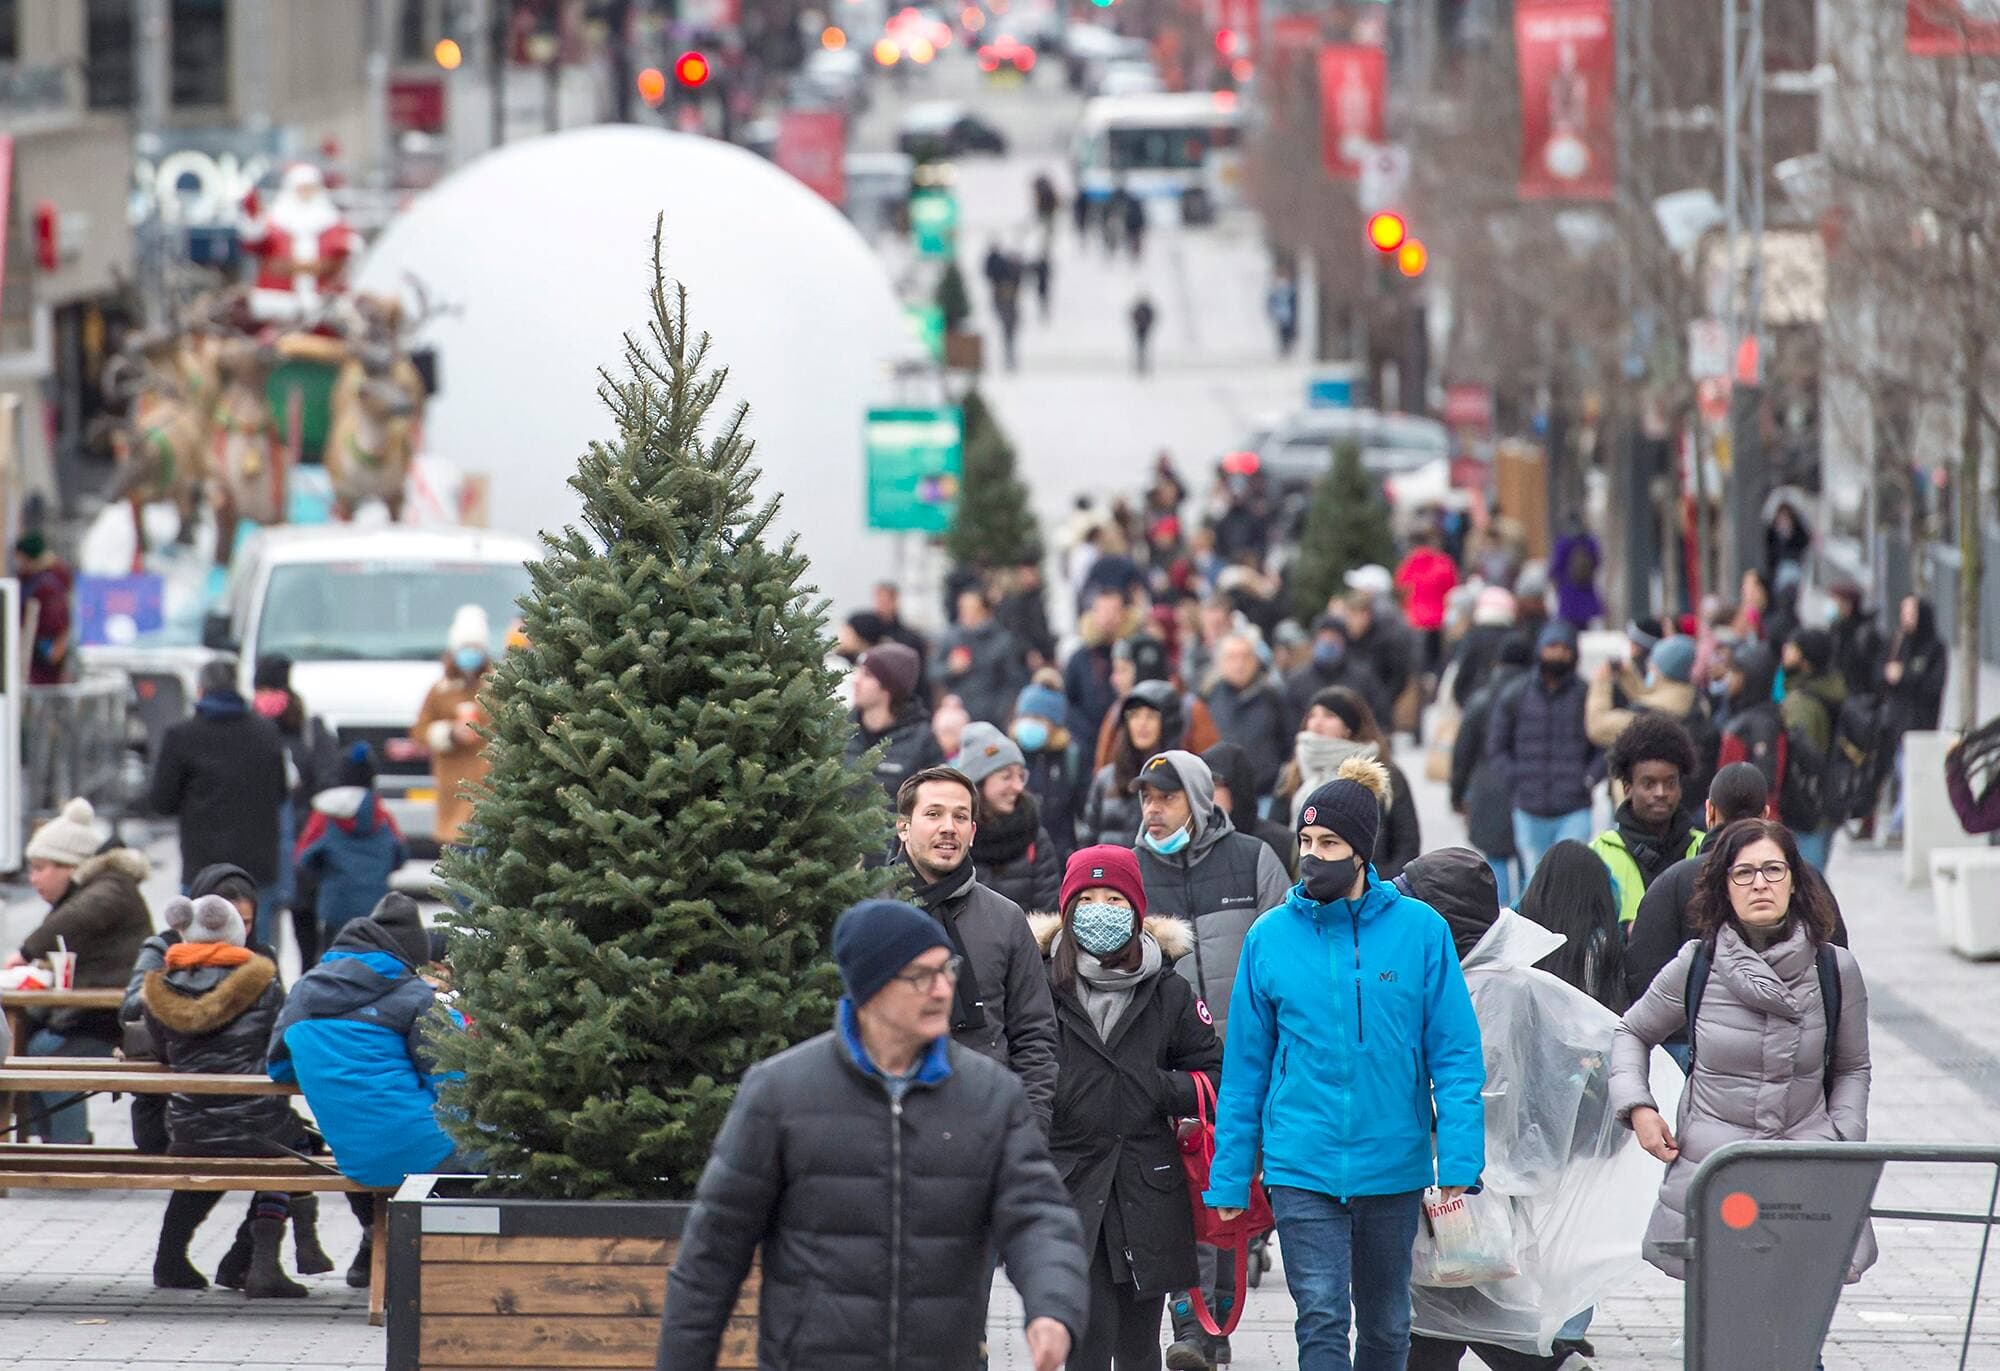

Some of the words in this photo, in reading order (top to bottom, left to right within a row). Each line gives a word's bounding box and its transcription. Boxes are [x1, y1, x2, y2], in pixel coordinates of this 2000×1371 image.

[1760, 1202, 1802, 1211] QUARTIER
[1759, 1212, 1777, 1220] DES
[1779, 1212, 1832, 1222] SPECTACLES
